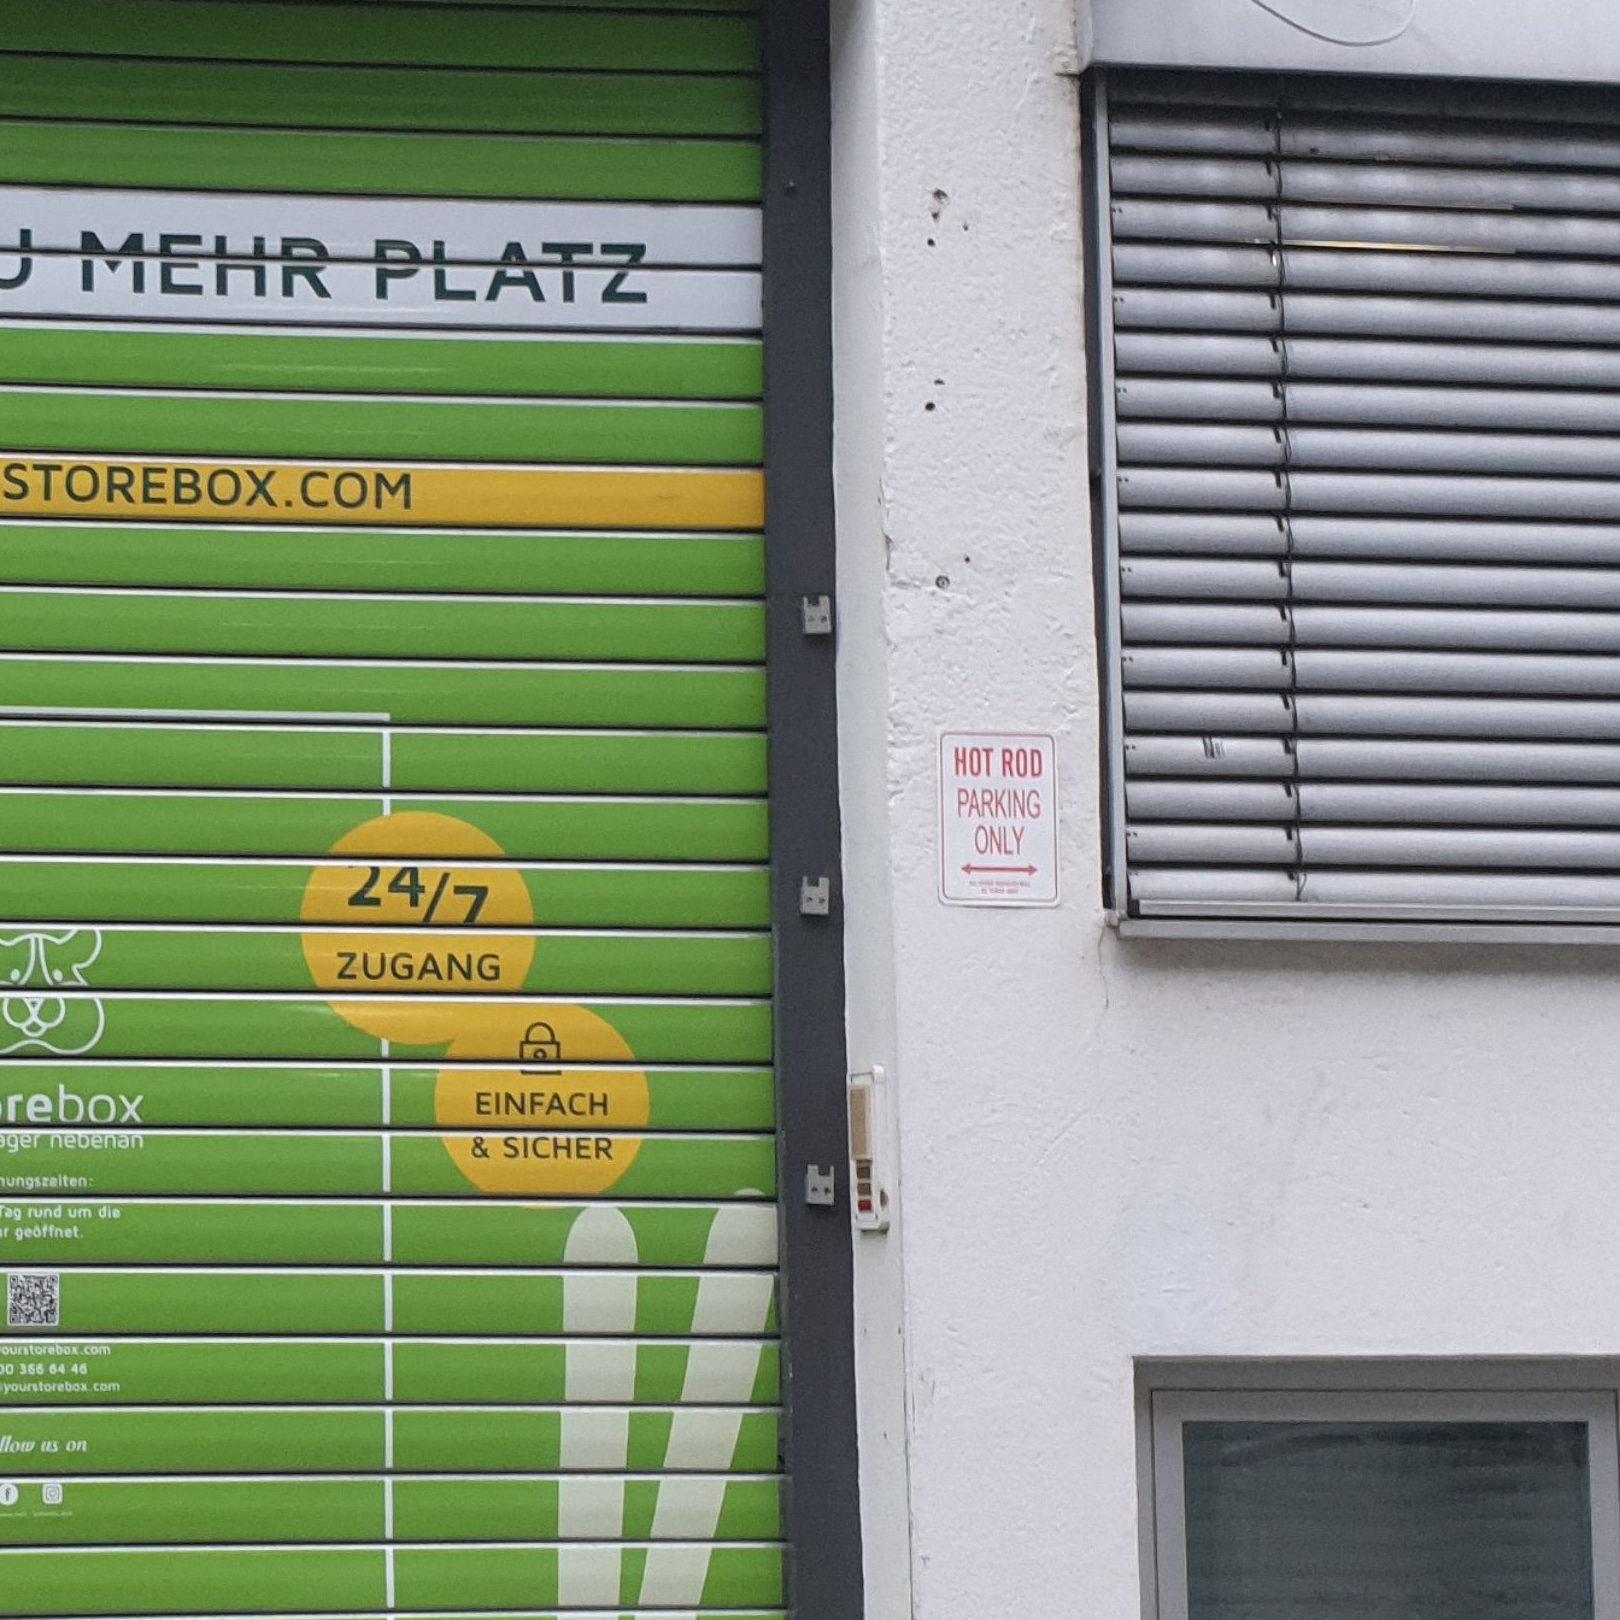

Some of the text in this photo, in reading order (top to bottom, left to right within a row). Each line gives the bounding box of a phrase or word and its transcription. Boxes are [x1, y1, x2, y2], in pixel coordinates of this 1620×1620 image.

[79, 230, 330, 300] MEHR
[372, 238, 650, 306] PLATZ
[954, 746, 1043, 778] HOT ROD
[957, 787, 1041, 820] PARKING
[974, 826, 1025, 856] ONLY
[347, 866, 489, 924] 24/7
[336, 952, 502, 981] ZUGANG
[475, 1091, 610, 1117] EINFACH
[50, 1133, 144, 1149] nebenan
[471, 1135, 614, 1161] & SICHER
[27, 1205, 62, 1219] rund
[68, 1207, 92, 1219] um
[98, 1205, 121, 1219] die
[15, 1224, 84, 1241] geöffnet.
[48, 1363, 66, 1376] 64
[71, 1363, 88, 1376] 46
[40, 1439, 60, 1453] us
[66, 1439, 88, 1452] on
